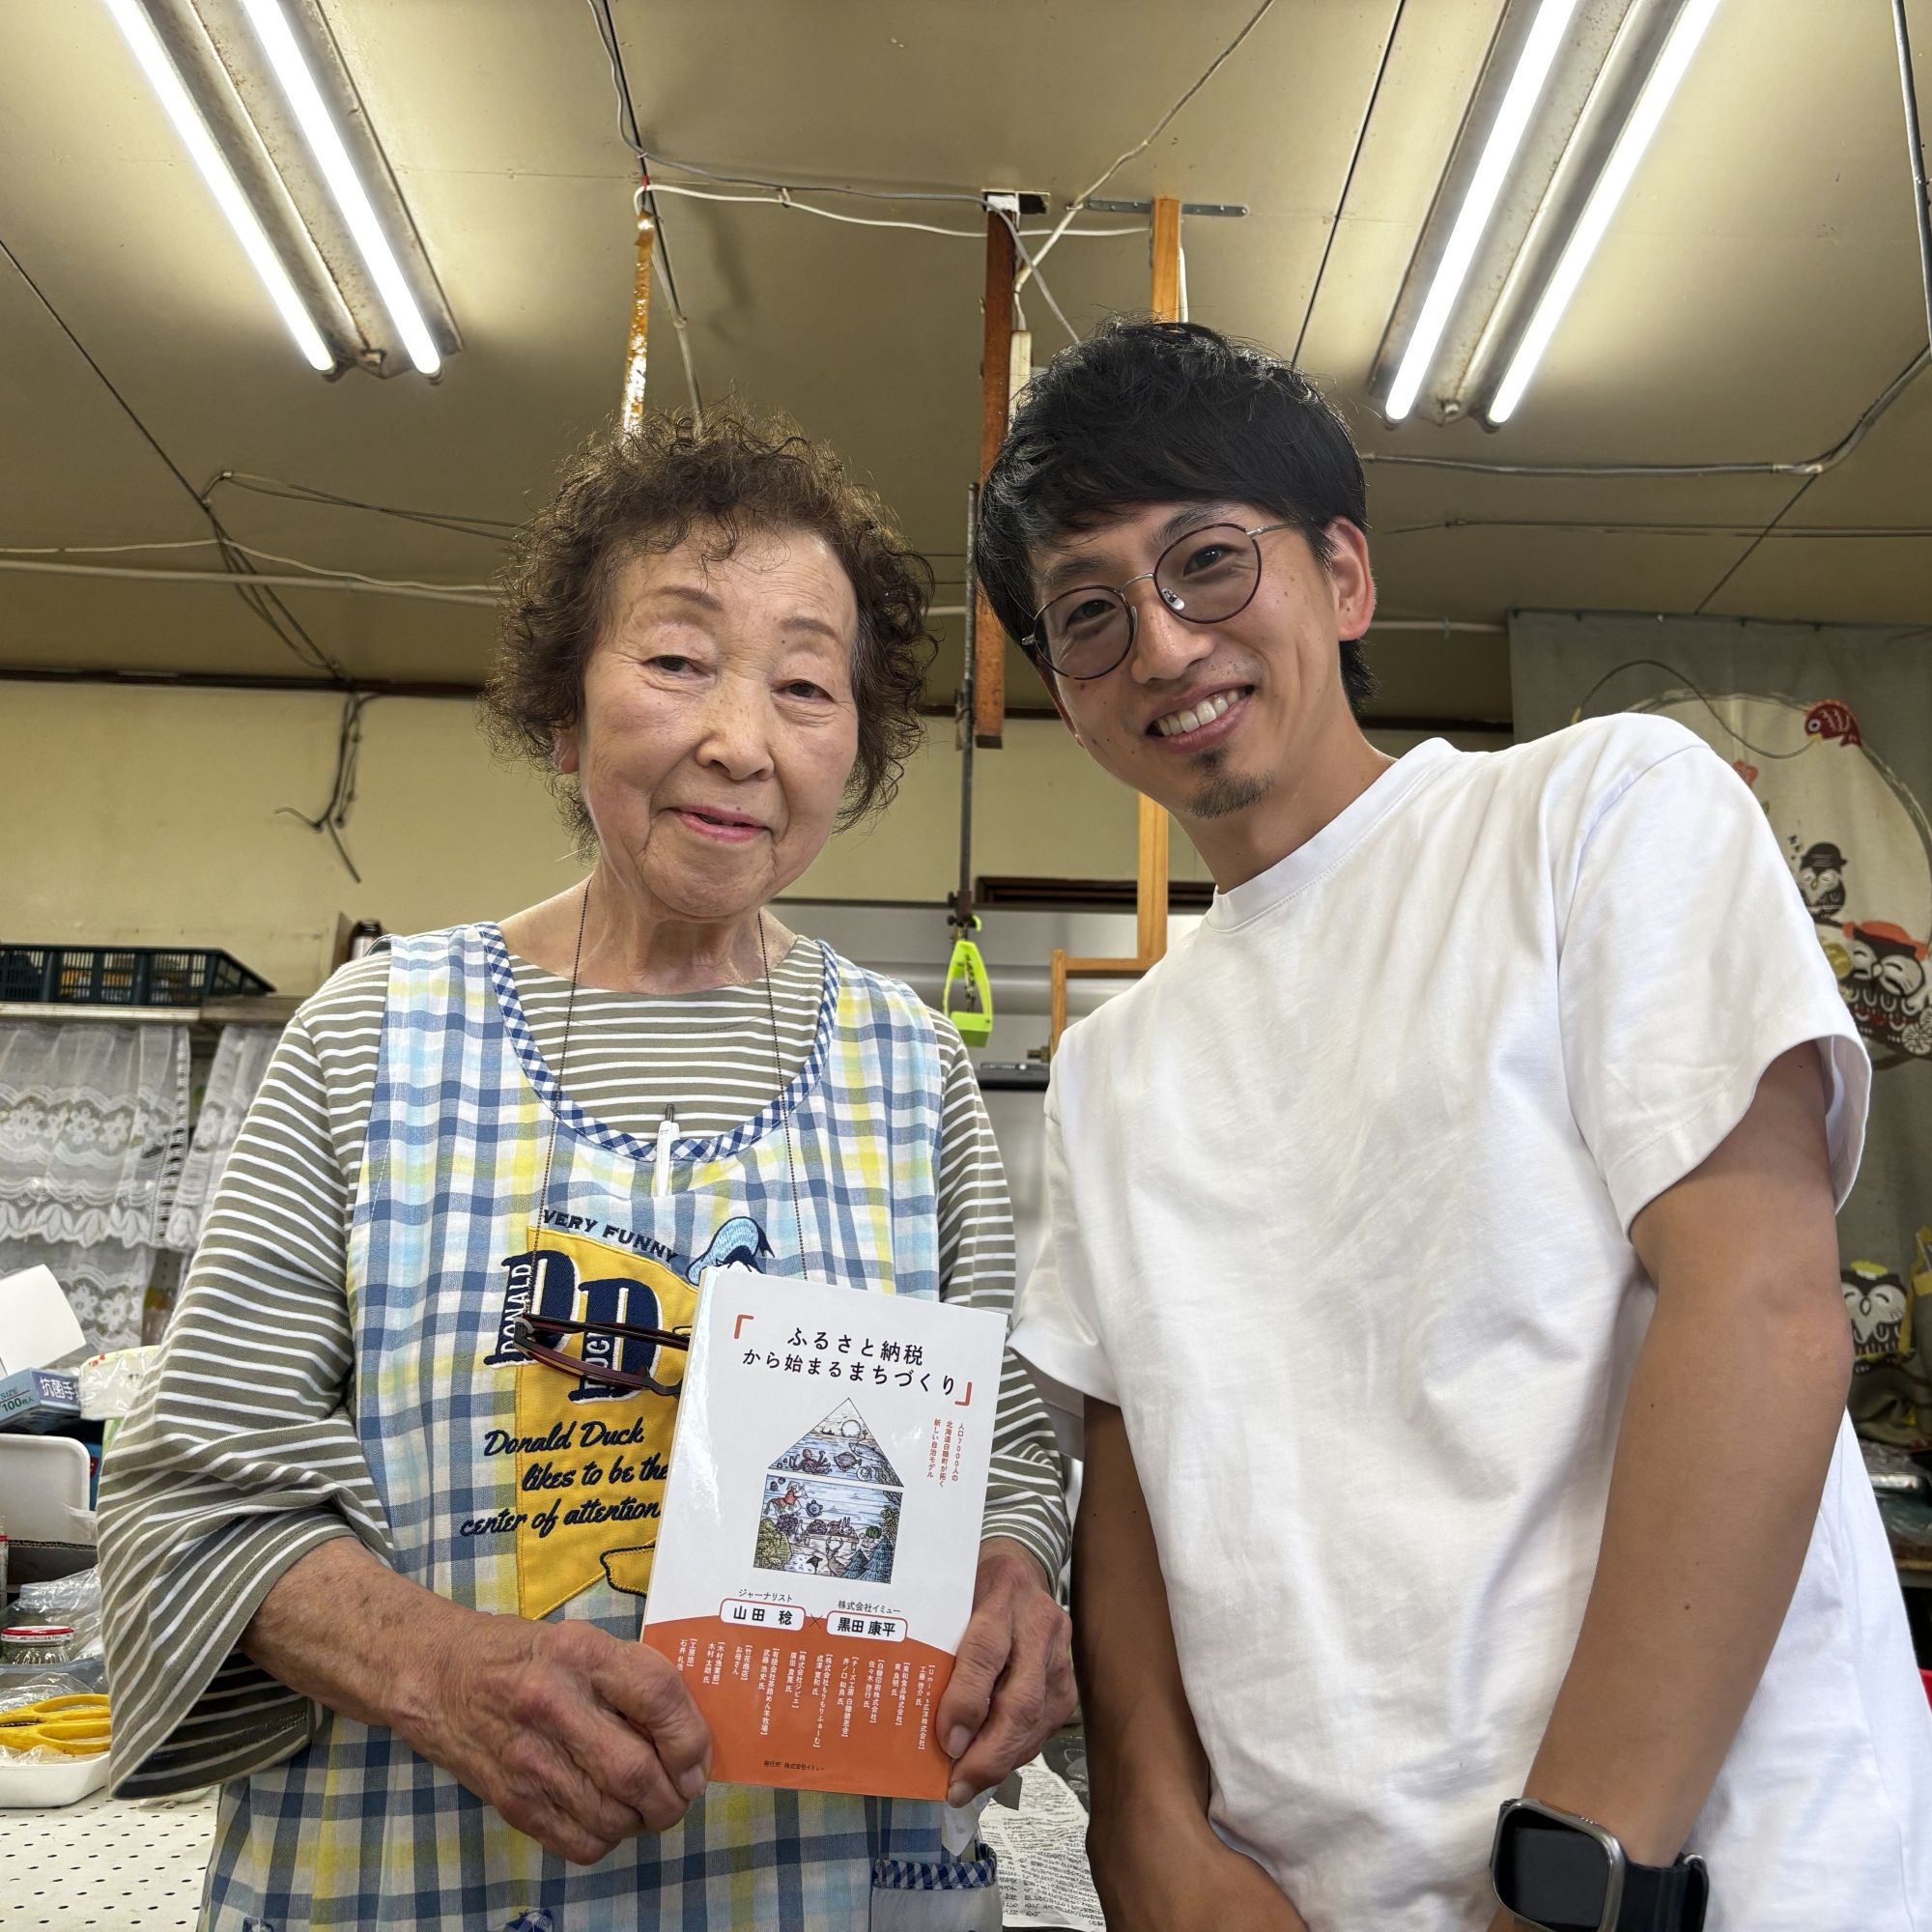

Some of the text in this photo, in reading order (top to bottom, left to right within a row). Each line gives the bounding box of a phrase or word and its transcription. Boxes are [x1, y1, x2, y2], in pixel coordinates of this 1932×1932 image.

[542, 1209, 679, 1264] VERY FUNNY
[787, 1327, 923, 1366] ふるさと納税
[40, 1377, 79, 1401] 抗菌手
[484, 1416, 644, 1457] Donald Duck
[522, 1452, 669, 1492] likes to be the
[460, 1496, 661, 1538] center of attention
[738, 1588, 793, 1604] ジャーナリスト
[838, 1600, 901, 1614] 株式会社イミュー
